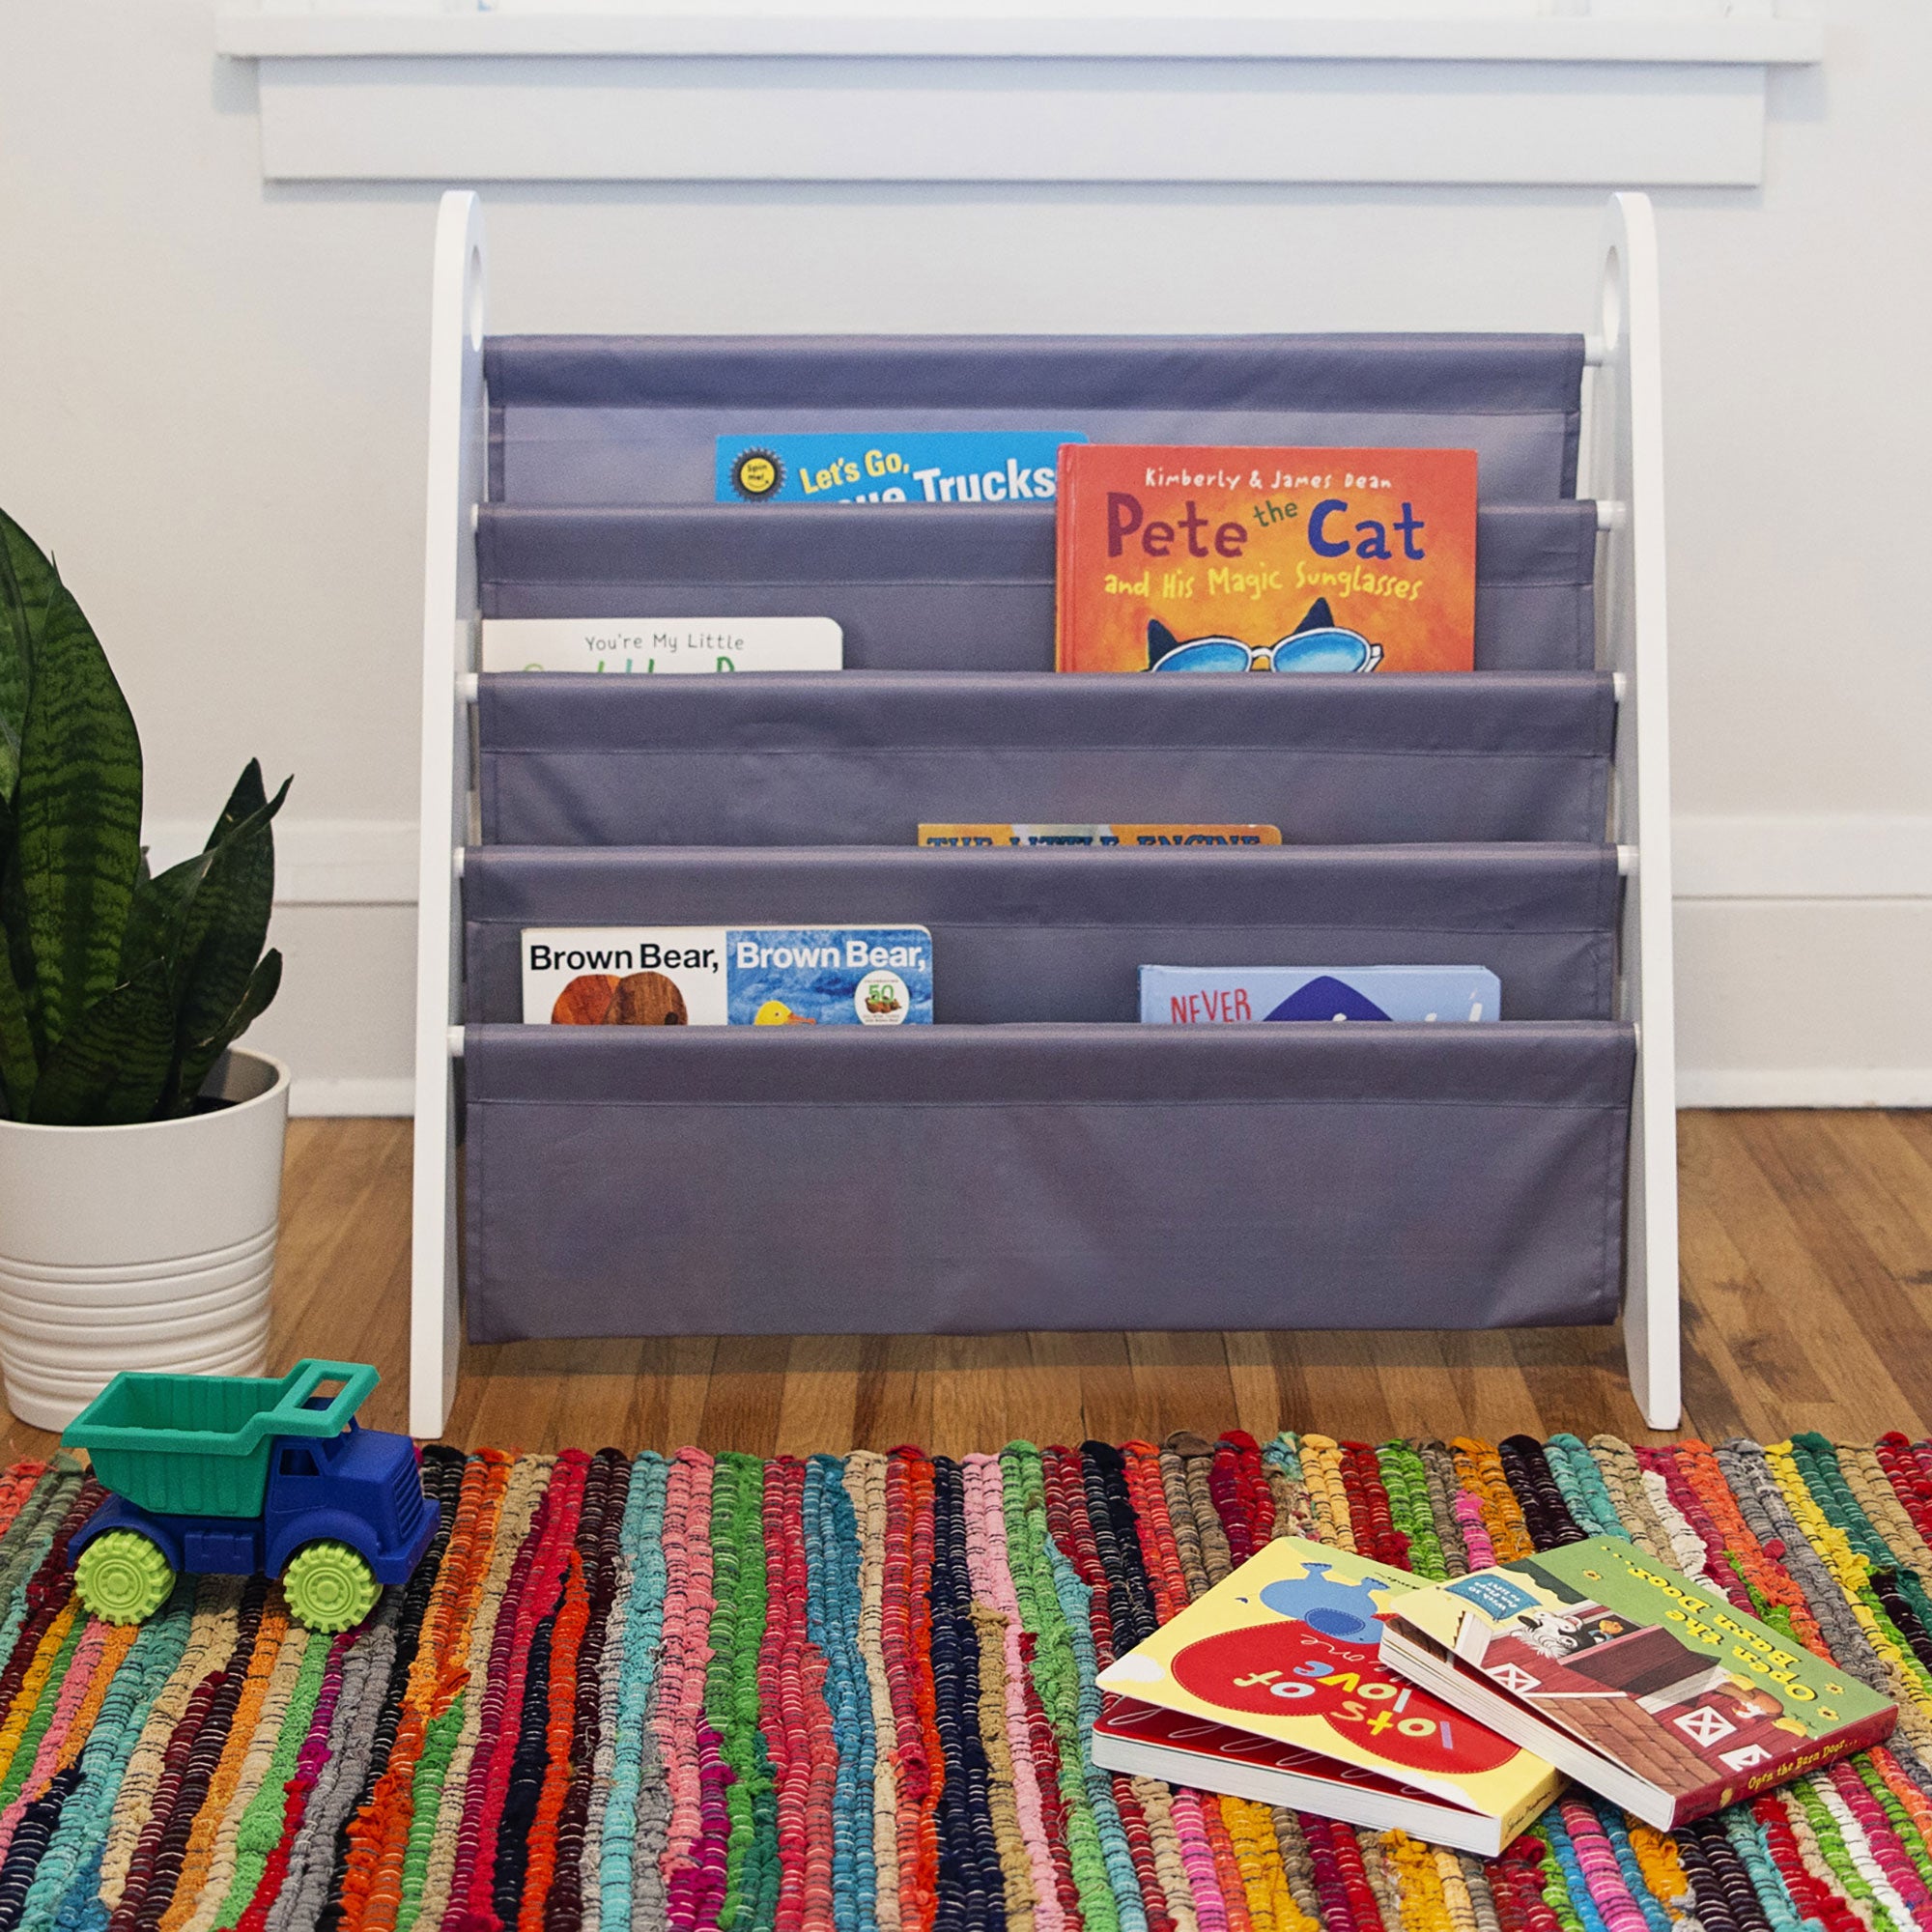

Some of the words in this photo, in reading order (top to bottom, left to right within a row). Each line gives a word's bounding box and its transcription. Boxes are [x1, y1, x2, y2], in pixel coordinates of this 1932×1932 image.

[799, 457, 861, 494] Let's
[865, 449, 910, 477] Go,
[913, 458, 1057, 502] Trucks
[1145, 468, 1241, 491] Kimberly
[1249, 470, 1263, 489] &
[1270, 469, 1332, 489] James
[1344, 471, 1392, 489] Dean
[1106, 492, 1249, 558] Pete
[1253, 499, 1298, 528] the
[1308, 498, 1426, 560] Cat
[1104, 572, 1151, 598] and
[1162, 569, 1194, 598] His
[1208, 561, 1284, 600] Magic
[1294, 560, 1423, 601] Sunglasses
[584, 634, 642, 651] You're
[653, 634, 677, 653] My
[688, 634, 745, 651] Little
[530, 945, 633, 971] Brown
[640, 944, 720, 973] Bear,
[736, 941, 839, 968] Brown
[846, 941, 926, 972] Bear,
[868, 983, 894, 1004] 50
[1171, 988, 1251, 1023] NEVER
[1664, 1608, 1723, 1647] the
[1713, 1613, 1801, 1669] Barn
[1300, 1634, 1365, 1662] one
[1233, 1669, 1316, 1698] of
[1293, 1660, 1411, 1713] love
[1731, 1644, 1818, 1702] Open
[1330, 1699, 1455, 1749] lots
[1748, 1772, 1773, 1789] Open
[1776, 1762, 1794, 1776] the
[1796, 1752, 1819, 1769] Barn
